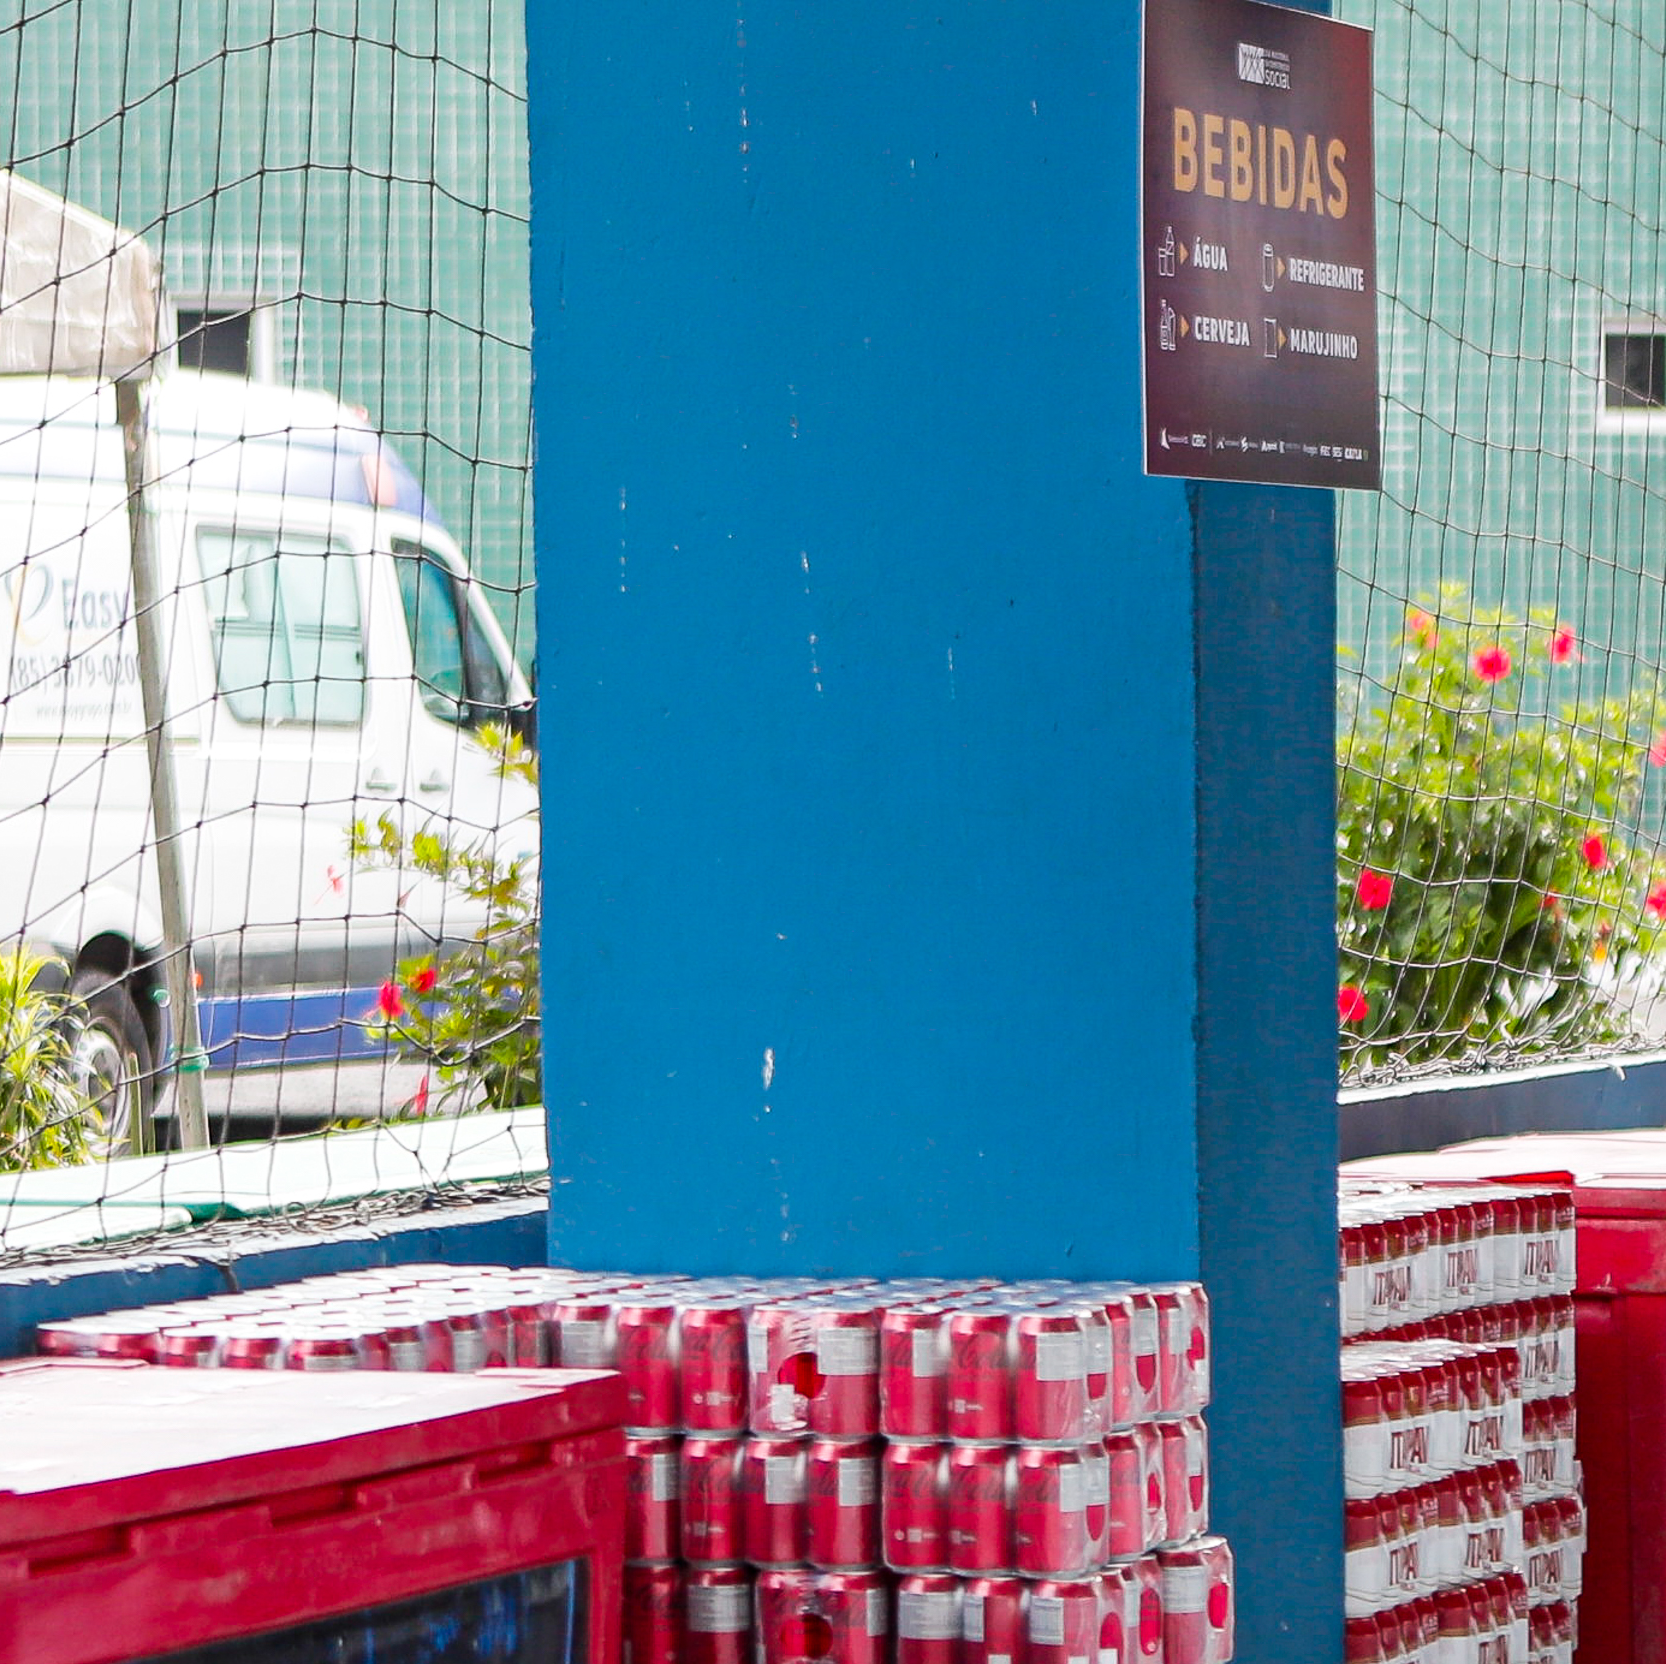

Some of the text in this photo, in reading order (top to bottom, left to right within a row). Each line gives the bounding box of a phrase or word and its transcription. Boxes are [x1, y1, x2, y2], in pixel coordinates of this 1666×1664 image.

[1173, 106, 1349, 220] BEBIDAS
[1192, 237, 1228, 272] ÁGUA
[1289, 257, 1365, 293] REFRIGERANTE
[1194, 315, 1251, 347] CERVEJA
[1290, 326, 1358, 360] MARUJINHO
